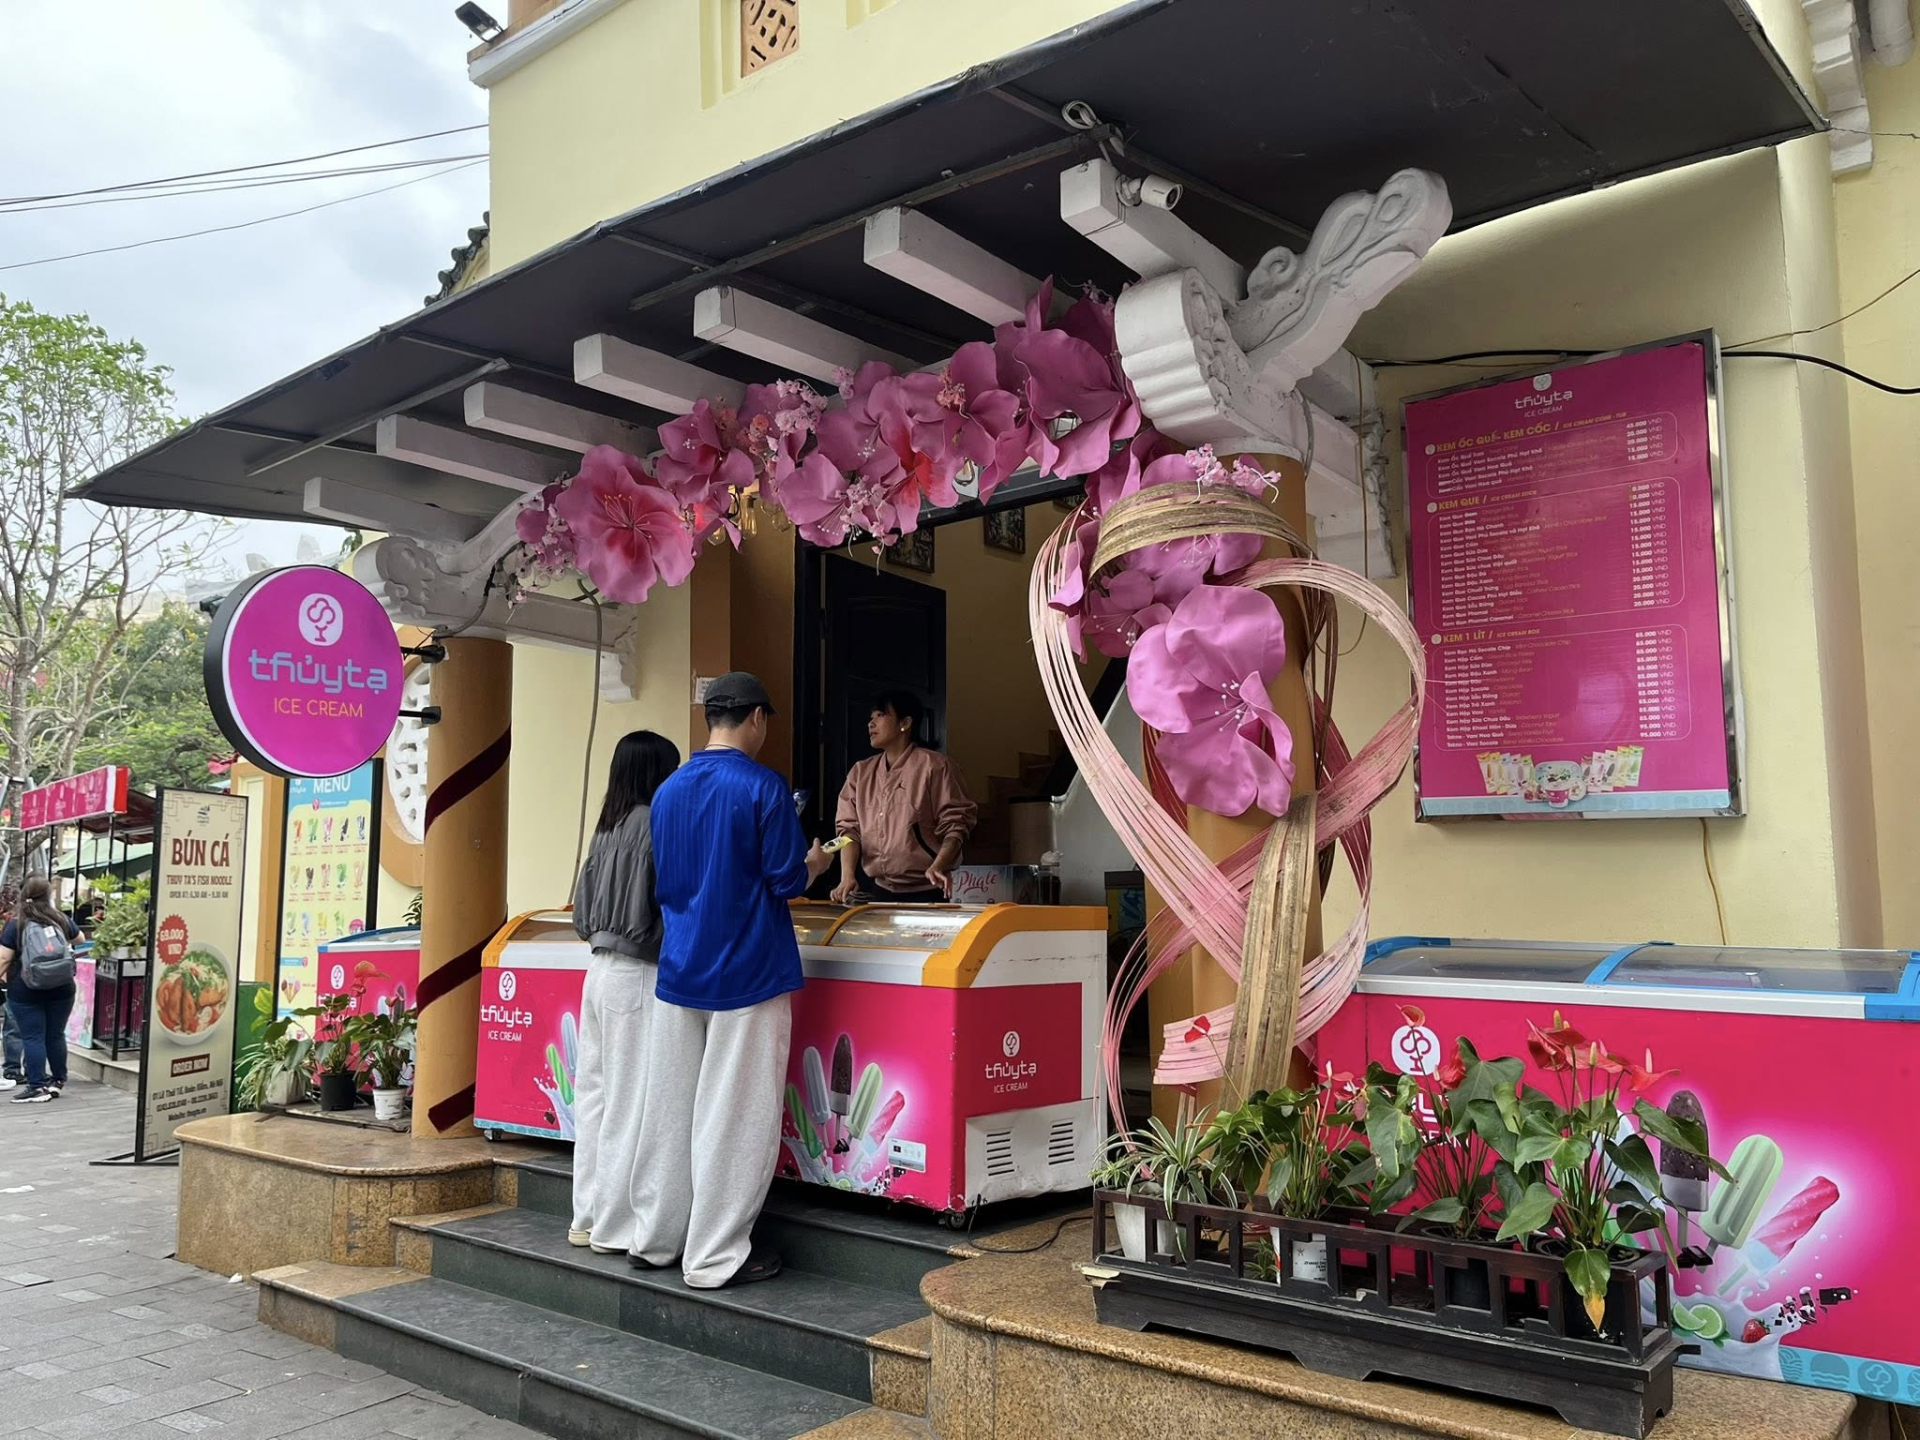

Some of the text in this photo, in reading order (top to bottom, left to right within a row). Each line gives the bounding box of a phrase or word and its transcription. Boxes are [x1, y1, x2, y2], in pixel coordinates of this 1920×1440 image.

[1537, 405, 1563, 415] CREAM
[1436, 441, 1456, 452] KEM
[1503, 429, 1524, 440] KEM
[1526, 421, 1551, 435] CỐC
[1648, 433, 1662, 441] VND
[1439, 499, 1458, 510] KEM
[1460, 496, 1479, 507] QUE
[1443, 635, 1462, 643] KEM
[1473, 630, 1486, 640] LÍT
[274, 697, 363, 718] ICE CREAM
[313, 773, 351, 794] MENU
[171, 830, 230, 867] BÚN CÁ
[210, 875, 233, 885] NOODLE
[488, 1030, 522, 1041] ICE CREAM
[994, 1082, 1028, 1094] ICE CREAM
